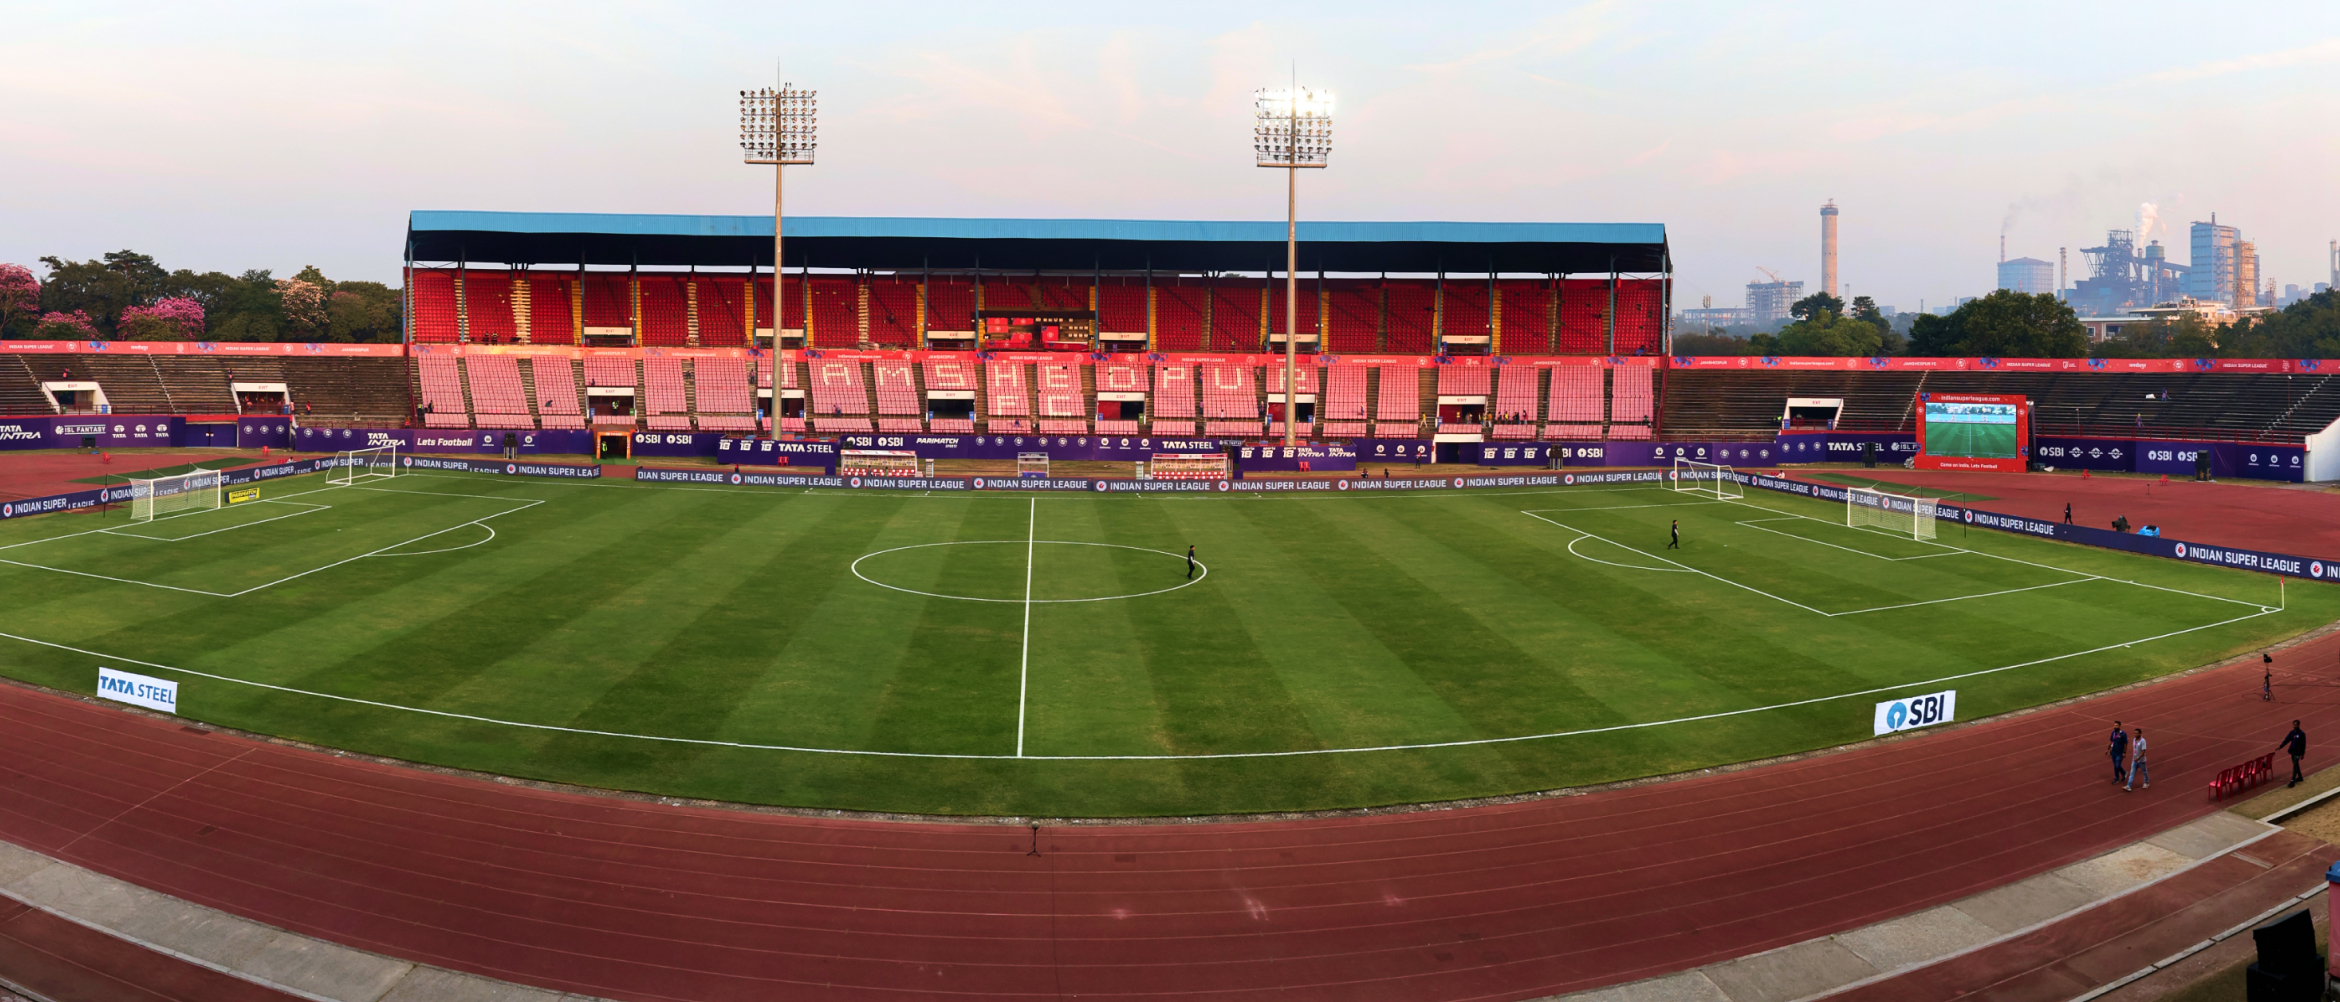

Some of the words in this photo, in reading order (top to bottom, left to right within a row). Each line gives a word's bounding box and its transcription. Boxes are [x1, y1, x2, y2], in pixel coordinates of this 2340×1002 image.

[438, 438, 473, 446] Football
[645, 435, 661, 443] SBI
[676, 435, 692, 444] SBI
[856, 437, 872, 446] SBI
[888, 437, 903, 446] SBI
[720, 442, 730, 450] 18
[740, 442, 751, 450] 18
[761, 443, 772, 451] 18
[778, 444, 805, 452] TATA
[807, 445, 834, 453] STEEL
[1857, 443, 1884, 451] STEL
[1587, 448, 1603, 457] SBI
[2049, 447, 2064, 457] SBI
[2157, 451, 2172, 461] SBI
[415, 459, 441, 468] INDIAN
[443, 461, 467, 470] SUPER
[519, 466, 547, 474] INDIAN
[548, 467, 575, 476] SUPER
[661, 472, 688, 480] SUPER
[691, 473, 724, 481] LEAGUE
[745, 476, 775, 484] INDIAN
[777, 477, 806, 485] SUPER
[808, 478, 842, 486] LEAGUE
[1577, 474, 1604, 483] INDIAN
[192, 478, 212, 487] INDIAN
[864, 479, 895, 487] INDIAN
[898, 480, 927, 488] SUPER
[930, 480, 964, 488] LEAGUE
[988, 480, 1018, 488] INDIAN
[1021, 480, 1051, 488] SUPER
[1053, 480, 1087, 488] LEAGUE
[1110, 482, 1141, 490] INDIAN
[1144, 482, 1173, 490] SUPER
[1176, 482, 1210, 490] LEAGUE
[1467, 478, 1495, 486] INDIAN
[1498, 477, 1524, 485] SUPER
[1759, 478, 1774, 488] INDIAN
[1775, 480, 1788, 489] SUPER
[1790, 482, 1808, 493] LEAGUE
[111, 488, 133, 500] INDIAN
[1820, 487, 1838, 498] INDIAN
[1857, 494, 1878, 506] LEAGUE
[15, 503, 41, 514] INDIAN
[43, 498, 67, 510] SUPER
[1891, 499, 1912, 511] INDIAN
[1935, 505, 1959, 519] LEAGUE
[1974, 512, 1998, 526] INDIAN
[2000, 516, 2023, 530] SUPER
[2026, 520, 2054, 535] LEAGUE
[2190, 547, 2222, 562] INDIAN
[2225, 552, 2258, 567] SUPER
[2260, 557, 2300, 573] LEAGUE
[100, 676, 134, 695] TATA
[137, 684, 174, 704] STEEL
[1908, 694, 1944, 726] SBI
